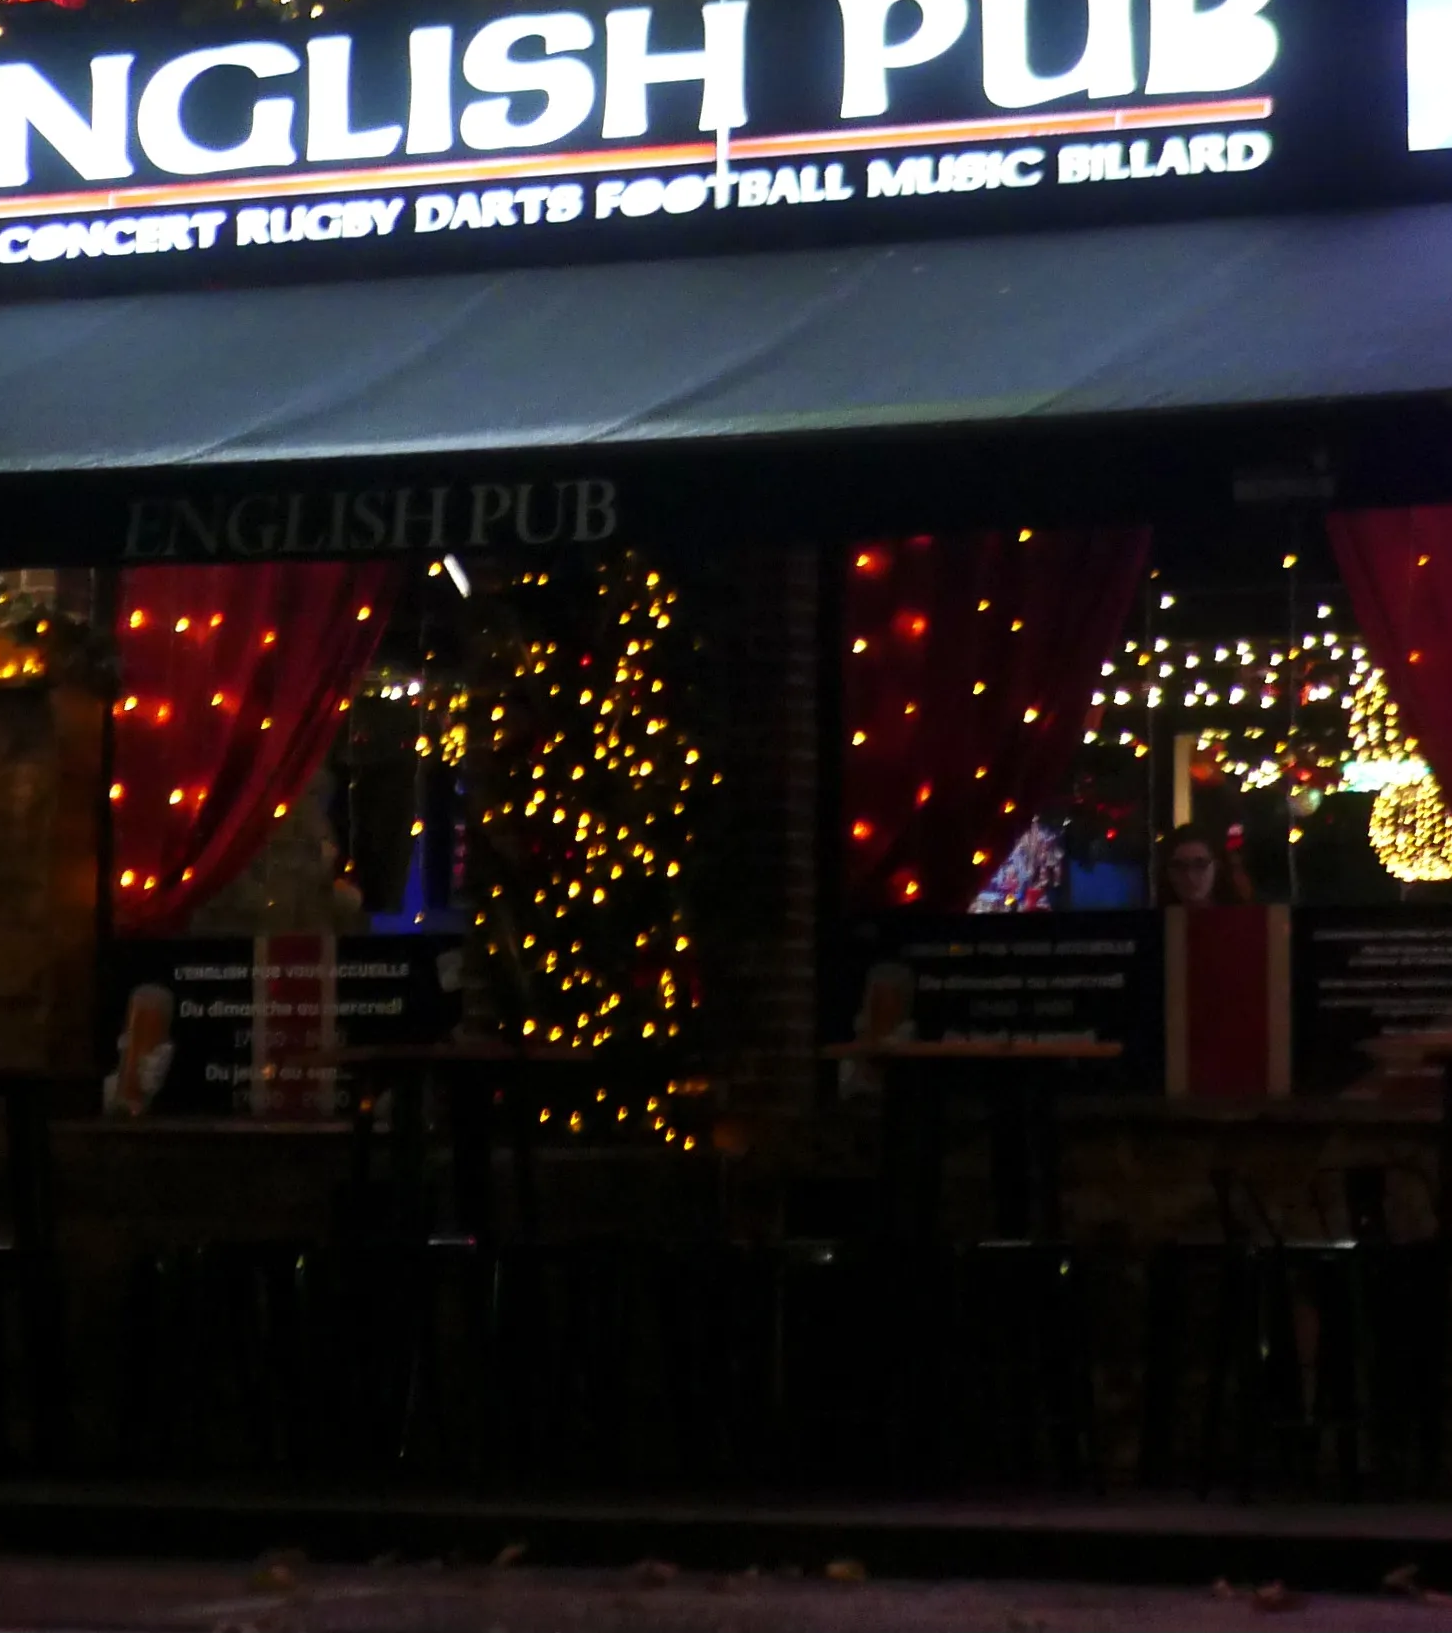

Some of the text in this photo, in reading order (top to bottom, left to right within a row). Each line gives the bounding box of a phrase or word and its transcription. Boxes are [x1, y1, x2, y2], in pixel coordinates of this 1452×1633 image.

[234, 197, 406, 247] RUGBY
[414, 182, 584, 233] DARTS
[595, 163, 853, 219] FOOTBALL
[866, 147, 1046, 198] MUSIC
[1057, 131, 1273, 184] BILLARD
[123, 477, 618, 557] ENGLISH PUB
